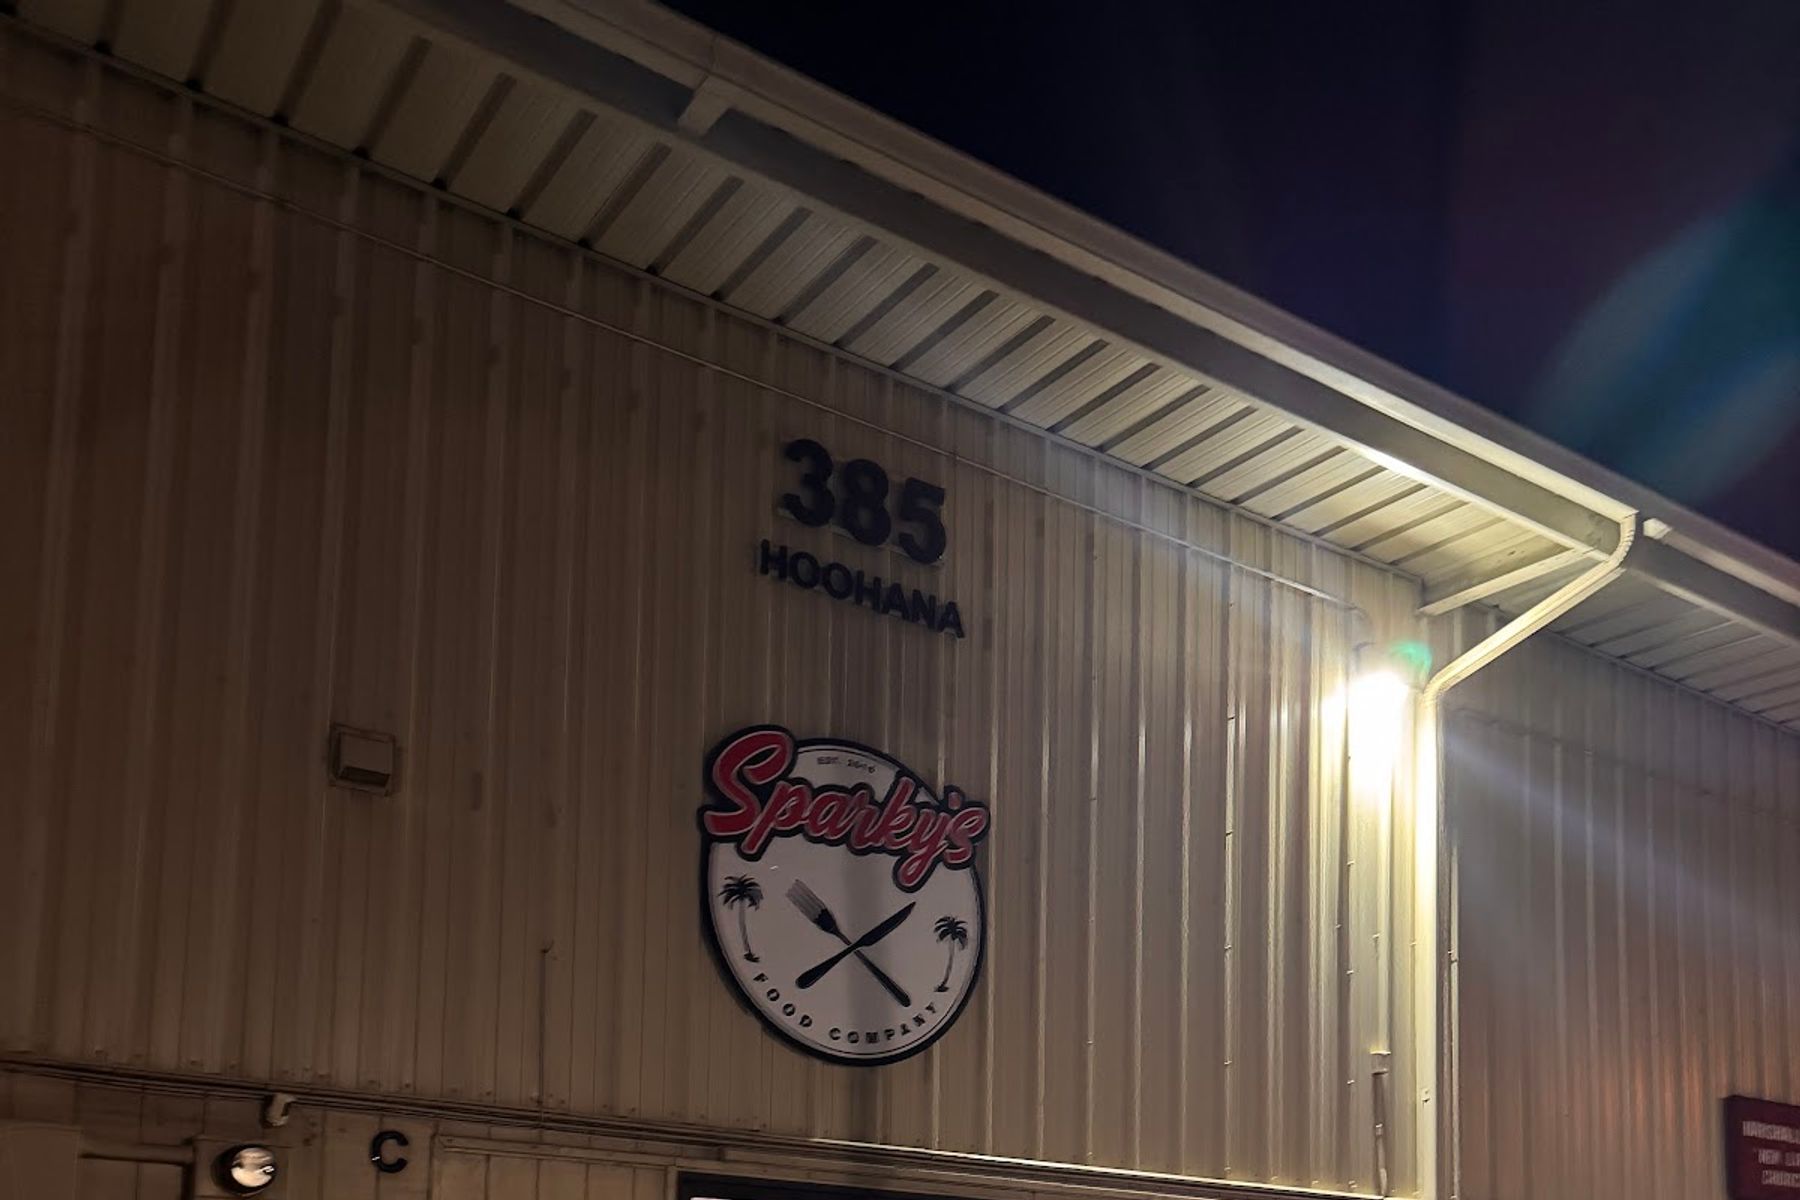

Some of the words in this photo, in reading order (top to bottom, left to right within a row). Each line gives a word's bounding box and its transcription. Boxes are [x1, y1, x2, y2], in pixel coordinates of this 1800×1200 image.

[783, 438, 946, 564] 385
[760, 539, 964, 639] HOOHANA
[700, 726, 989, 891] Sparky's
[753, 972, 813, 1028] FOOD
[829, 1002, 938, 1043] COMPANY
[371, 1130, 409, 1173] C
